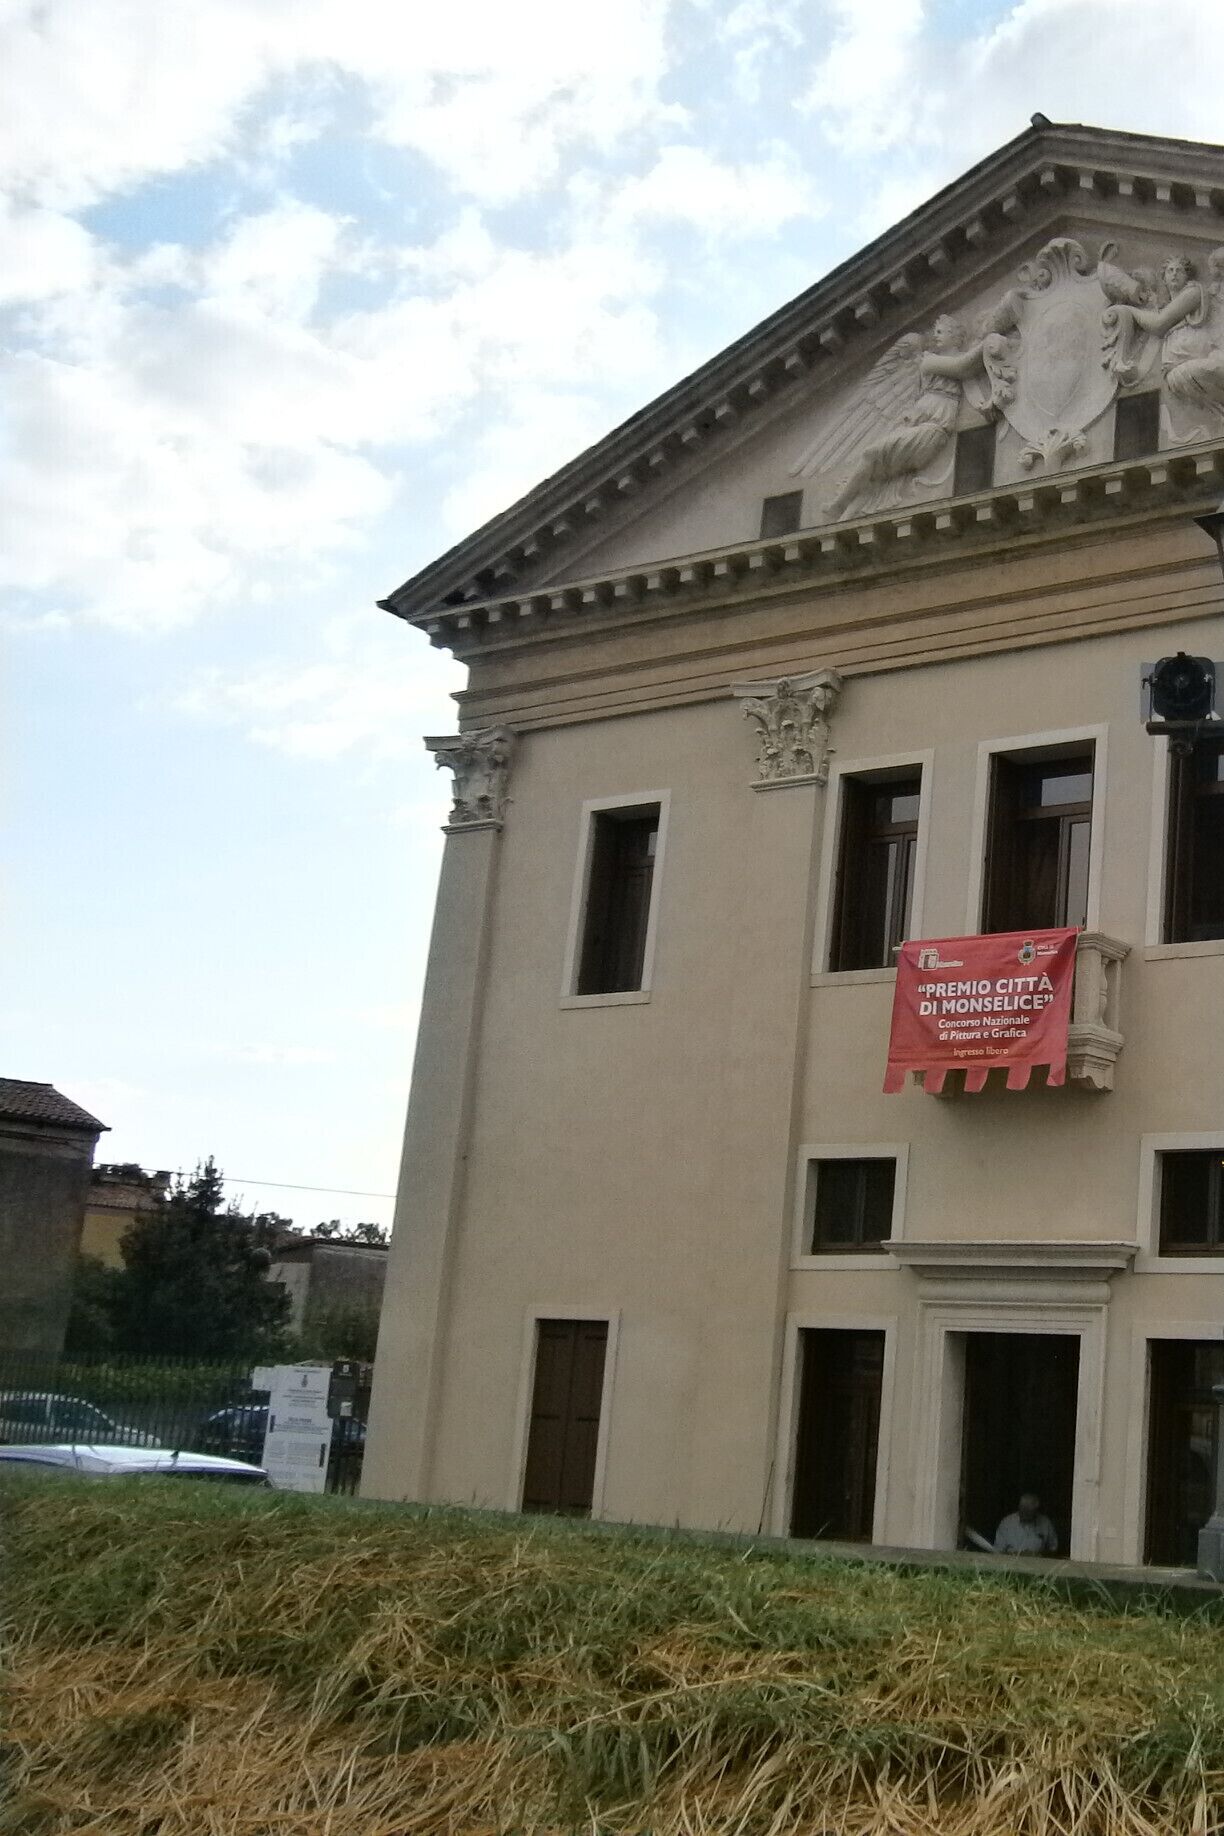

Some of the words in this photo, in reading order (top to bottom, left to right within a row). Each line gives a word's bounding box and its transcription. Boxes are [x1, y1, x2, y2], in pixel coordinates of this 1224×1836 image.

[995, 972, 1053, 993] CITTÀ
[919, 1002, 937, 1016] DI
[938, 1018, 980, 1029] Concorso
[982, 1015, 1030, 1026] Nazionale
[939, 1030, 948, 1041] di
[949, 1030, 981, 1040] Pittura
[991, 1028, 1027, 1038] Grafica
[953, 1048, 984, 1057] Ingresso
[986, 1047, 1009, 1056] libero
